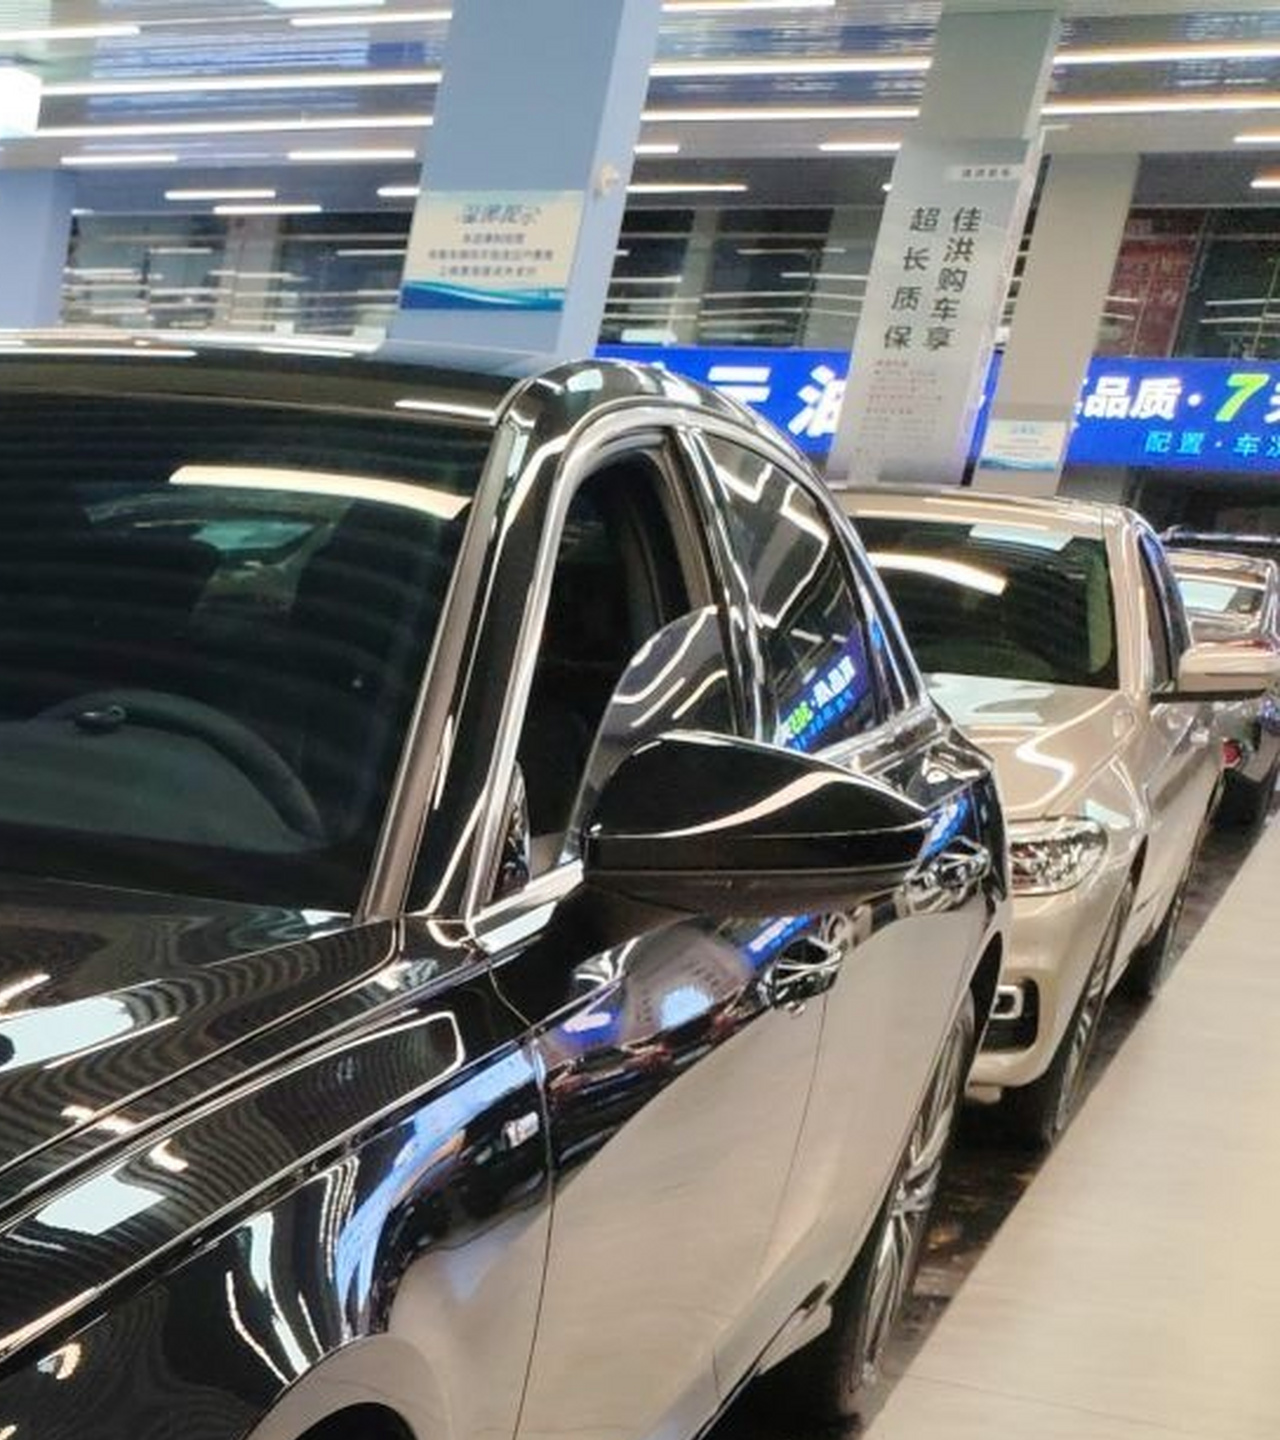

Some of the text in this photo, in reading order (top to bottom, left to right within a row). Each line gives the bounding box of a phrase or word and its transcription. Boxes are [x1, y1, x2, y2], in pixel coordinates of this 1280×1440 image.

[884, 207, 940, 350] 超长质保
[922, 206, 982, 350] 佳洪购车享
[1072, 372, 1280, 424] 品质·7
